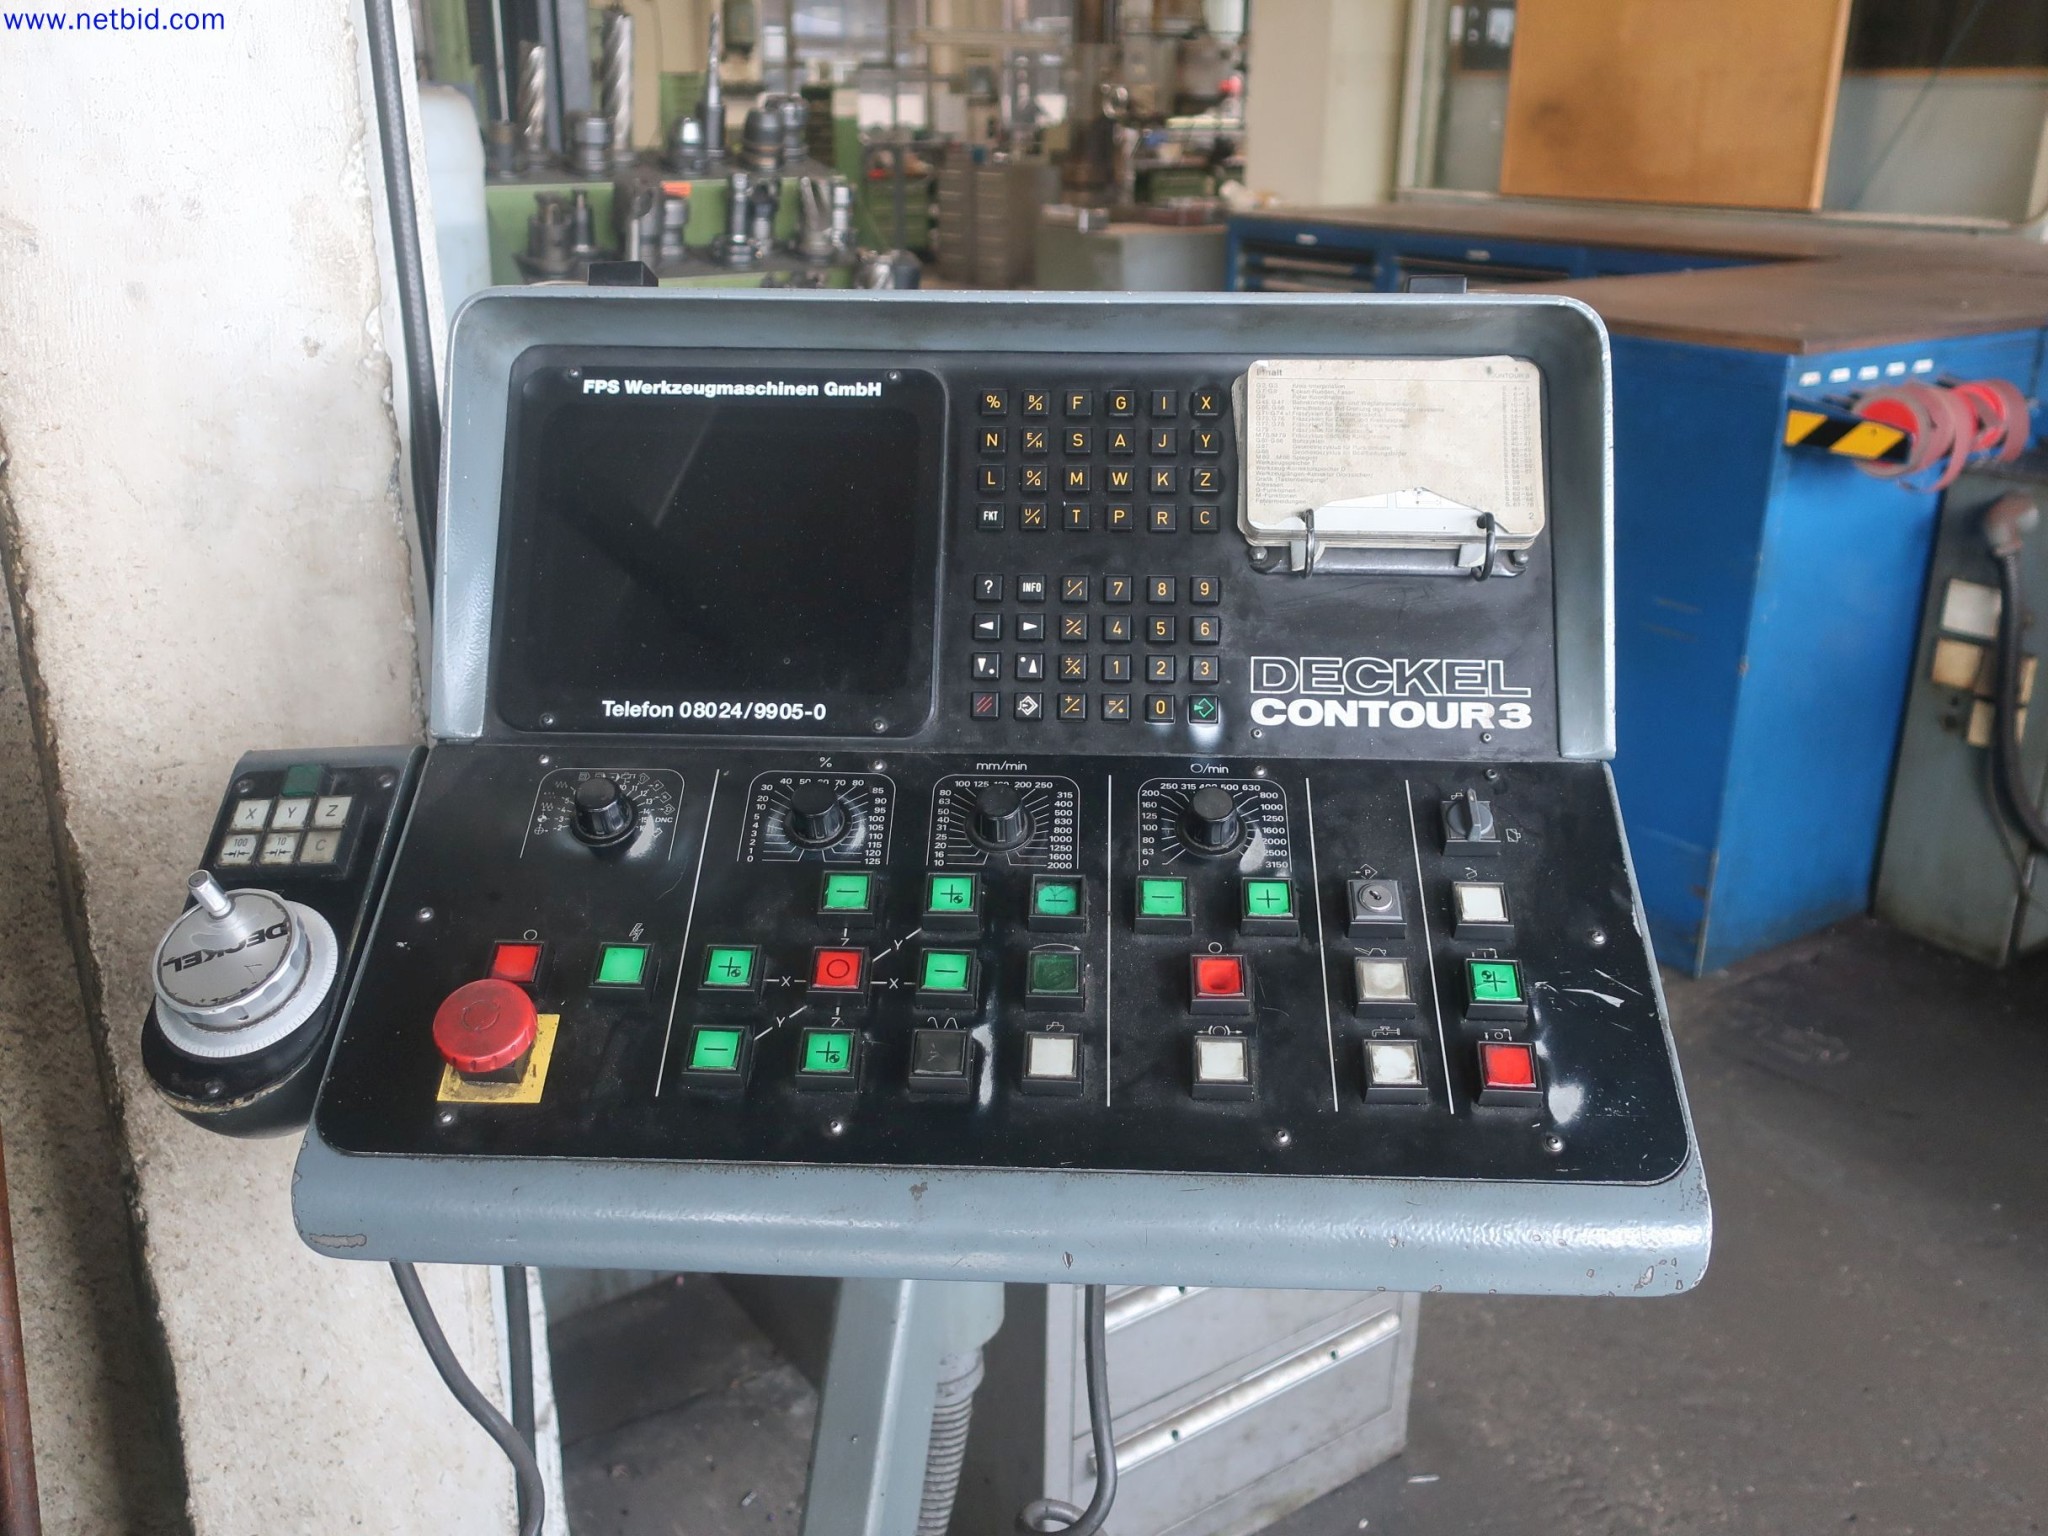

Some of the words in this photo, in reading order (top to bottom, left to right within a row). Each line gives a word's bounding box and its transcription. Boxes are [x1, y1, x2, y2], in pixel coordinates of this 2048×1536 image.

[583, 380, 619, 394] FPS
[625, 380, 818, 398] Werkzeugmaschinen
[824, 382, 882, 396] GmbH
[1073, 396, 1083, 409] F
[1115, 396, 1127, 410] G
[1201, 396, 1211, 410] X
[987, 433, 998, 446] N
[1073, 433, 1083, 447] S
[1114, 434, 1126, 447] A
[1158, 434, 1166, 448] J
[1201, 434, 1211, 448] Y
[987, 471, 995, 485] L
[1070, 471, 1083, 485] M
[1112, 472, 1128, 486] W
[1158, 472, 1168, 486] K
[1201, 472, 1211, 486] Z
[983, 510, 998, 521] FKT
[1073, 509, 1081, 523] T
[1114, 510, 1125, 523] P
[1157, 511, 1168, 524] R
[1200, 511, 1209, 524] C
[984, 580, 993, 593] ?
[1022, 582, 1041, 593] INFO
[1113, 582, 1123, 595] 7
[1157, 582, 1166, 596] 8
[1200, 582, 1209, 596] 9
[1112, 621, 1122, 635] 4
[1156, 622, 1165, 635] 5
[1201, 622, 1209, 636] 6
[1113, 661, 1119, 674] 1
[1156, 661, 1165, 675] 2
[1200, 661, 1209, 675] 3
[1250, 656, 1532, 698] DECKEL
[602, 700, 674, 718] Telefon
[679, 701, 827, 720] 08024/9905-0
[820, 757, 832, 768] %
[976, 761, 1027, 771] mm/min
[246, 808, 257, 819] X
[288, 807, 296, 818] Y
[326, 805, 338, 816] Z
[234, 839, 248, 847] 100
[315, 840, 326, 851] C
[894, 940, 903, 950] Y
[781, 976, 791, 986] X
[889, 978, 899, 989] X
[777, 1017, 785, 1028] Y
